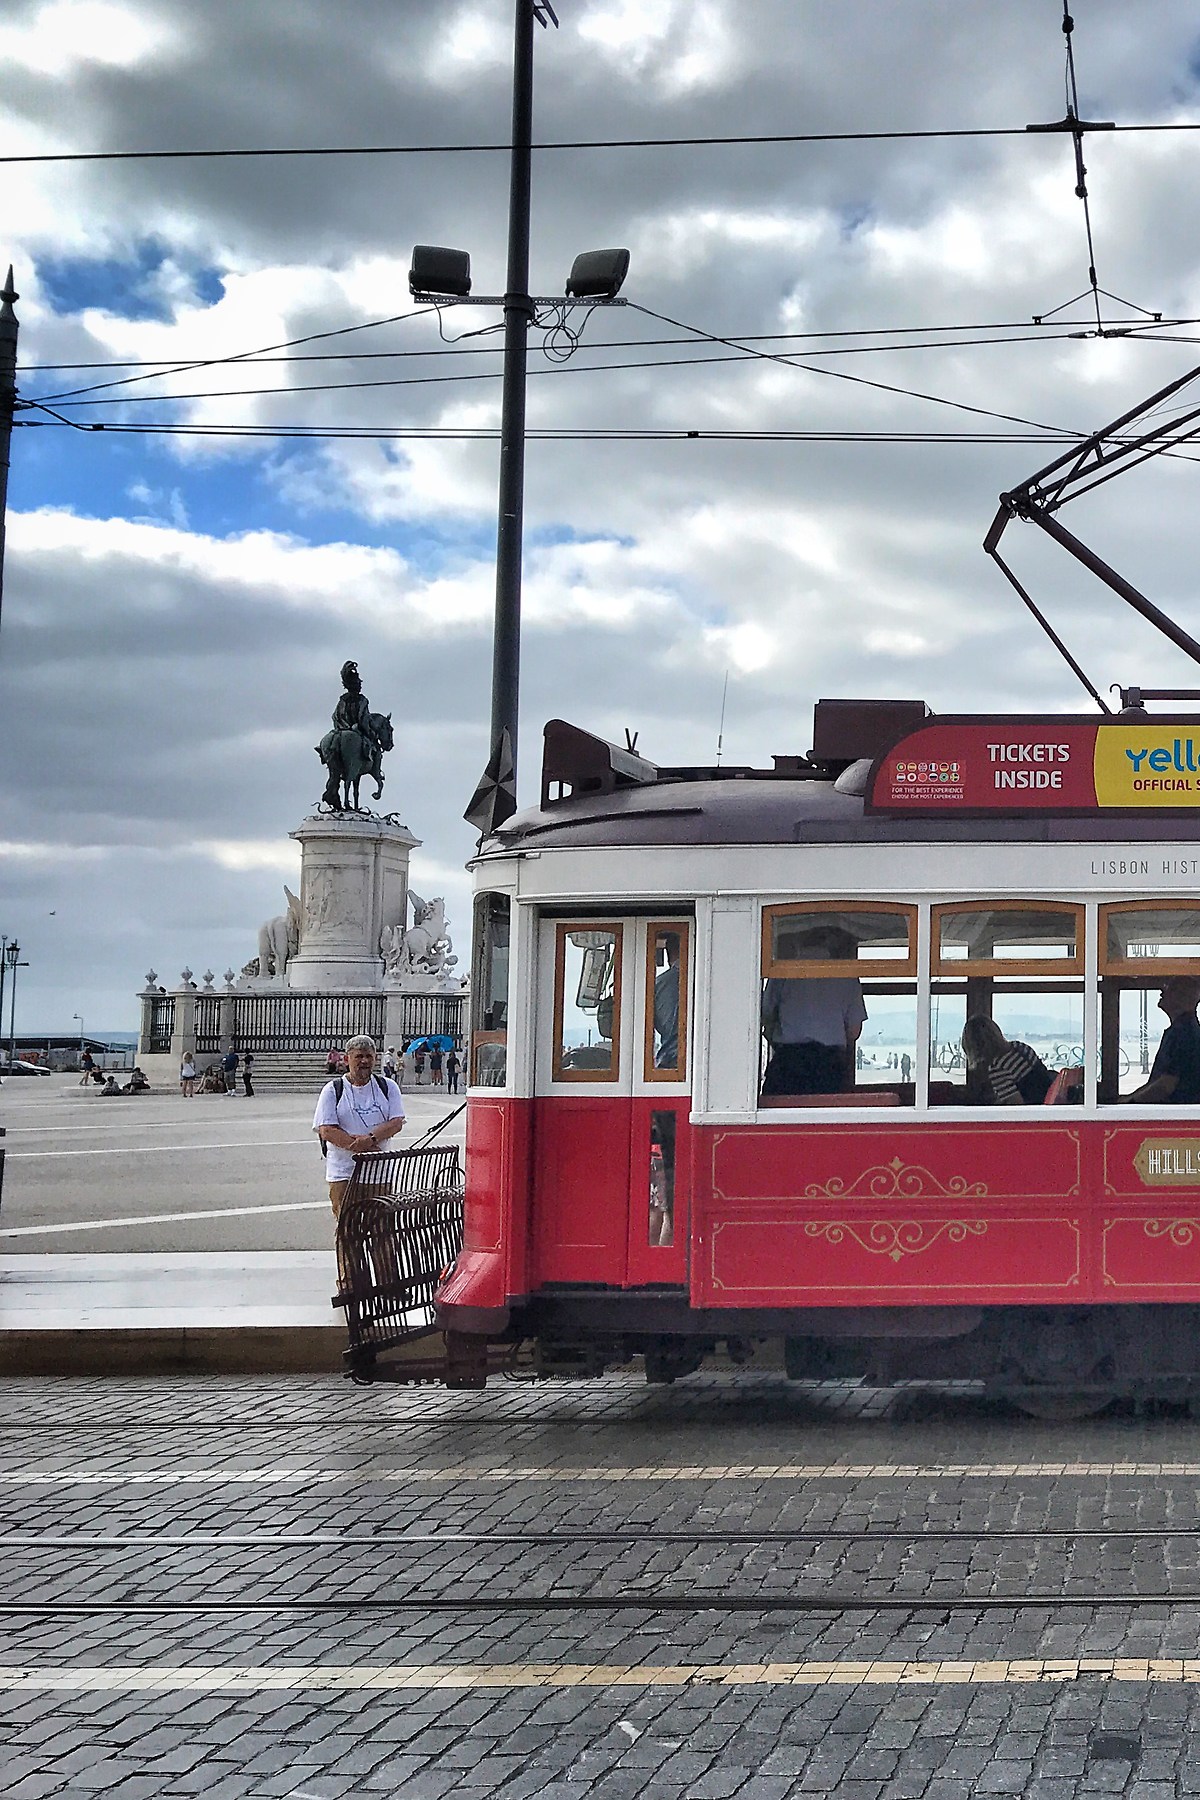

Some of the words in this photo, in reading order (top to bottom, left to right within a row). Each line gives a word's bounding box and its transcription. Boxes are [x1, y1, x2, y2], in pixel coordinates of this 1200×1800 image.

[987, 744, 1070, 763] TICKETS
[994, 771, 1062, 789] INSIDE
[1133, 779, 1193, 791] OFFICIAL
[1091, 860, 1149, 875] LISBON
